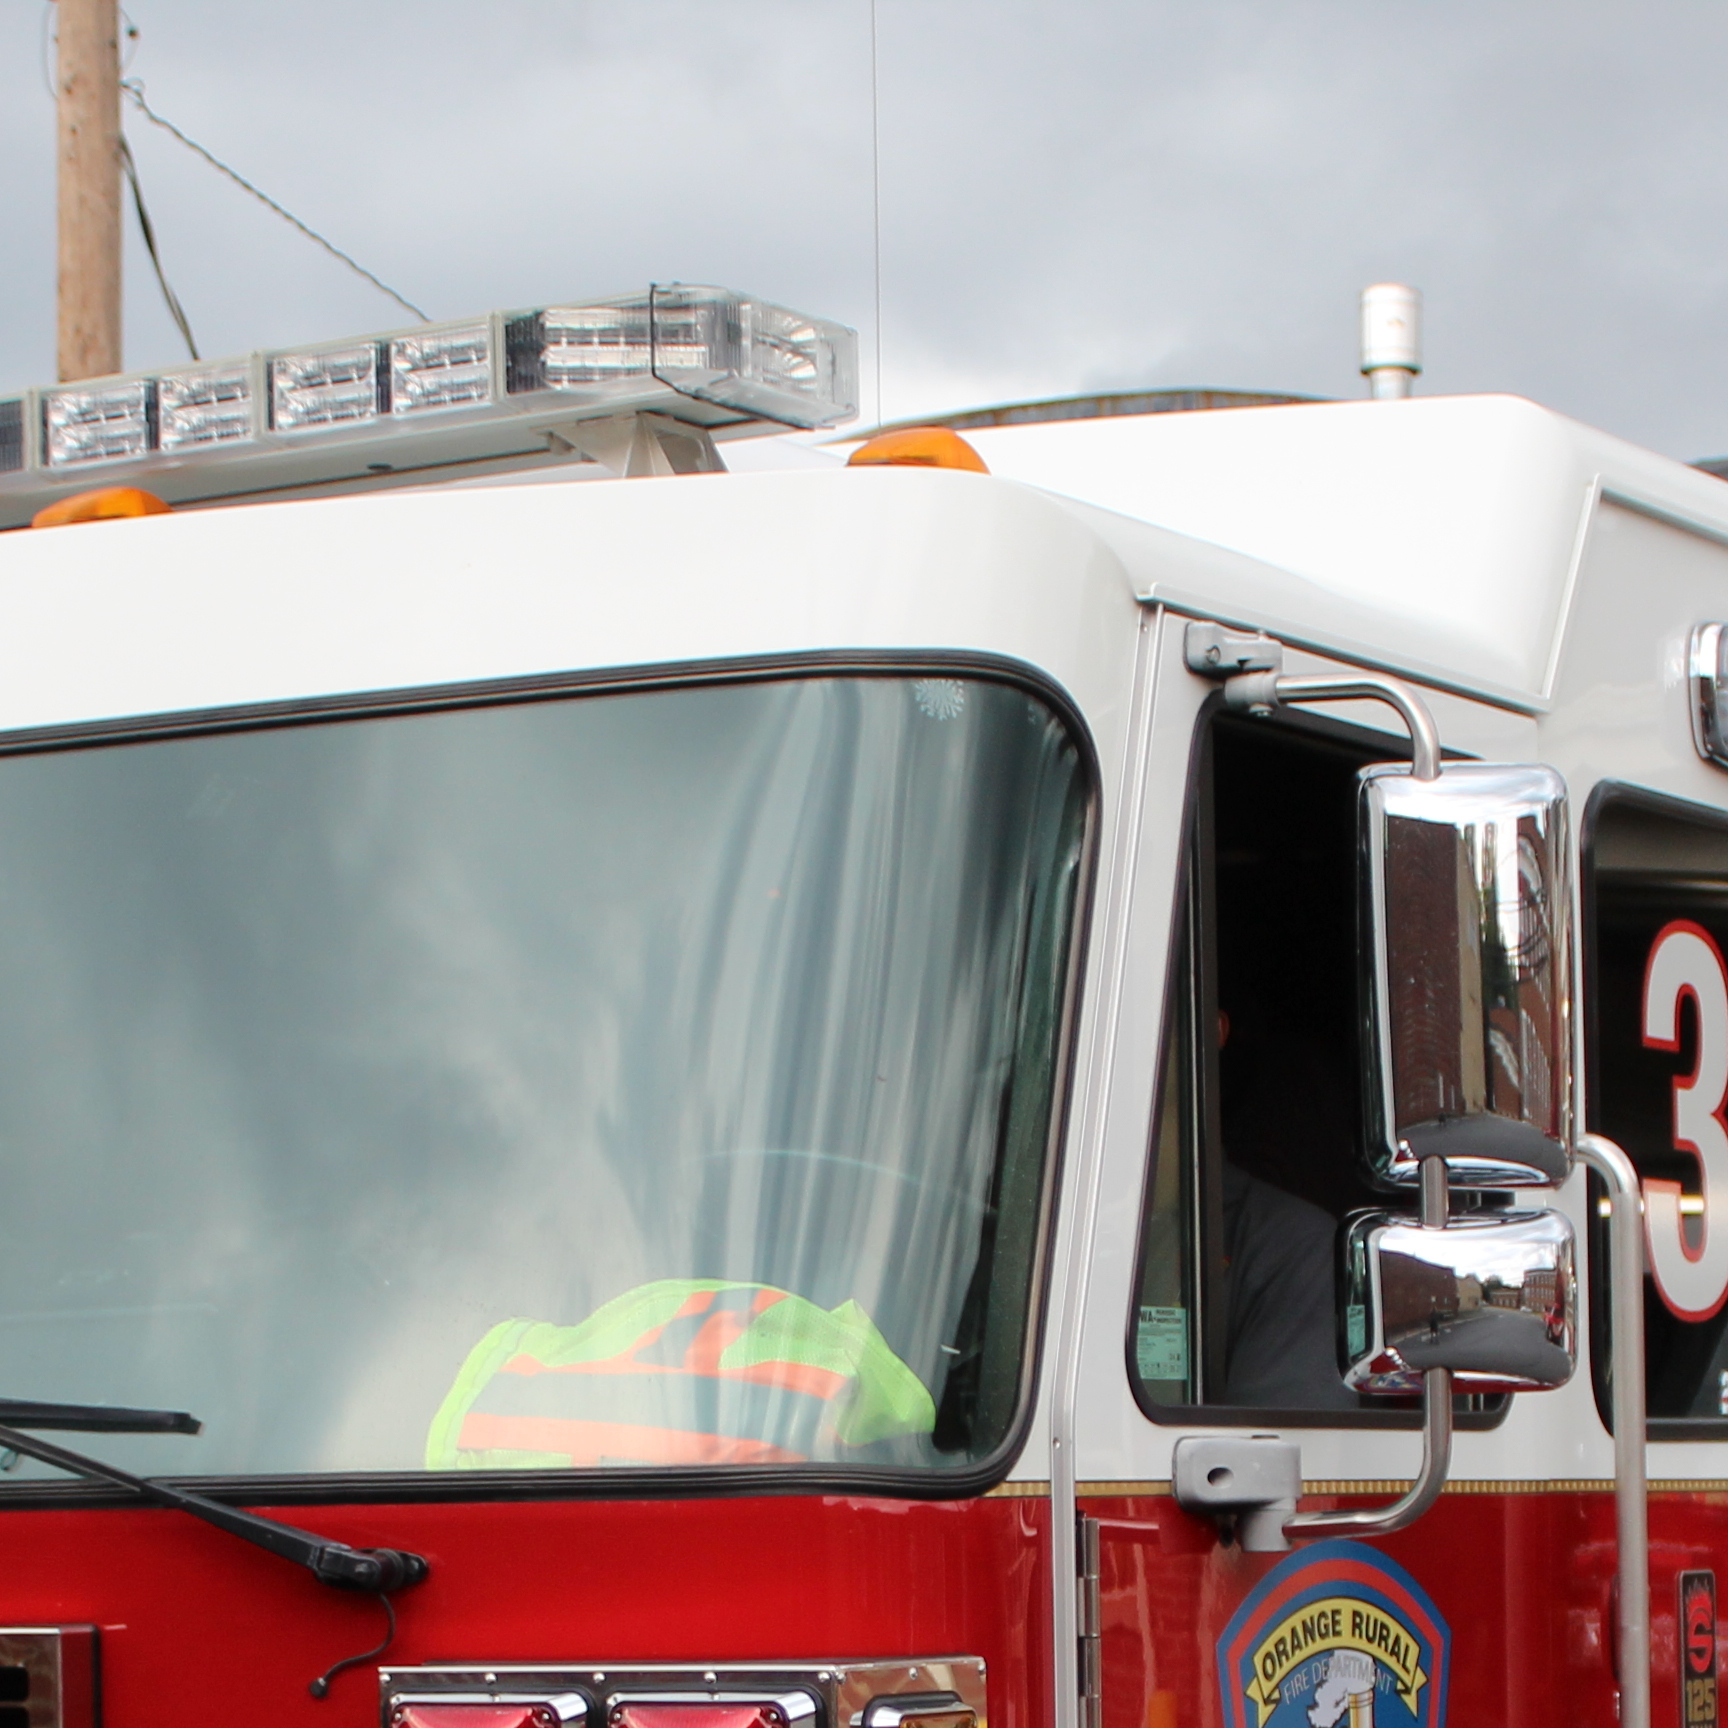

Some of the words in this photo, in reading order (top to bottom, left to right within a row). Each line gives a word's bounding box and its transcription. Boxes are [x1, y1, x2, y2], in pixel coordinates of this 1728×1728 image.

[1262, 1609, 1343, 1681] ORANGE
[1351, 1609, 1412, 1674] RURAL
[1283, 1667, 1310, 1705] FIRE
[1312, 1654, 1393, 1695] DEPARTMENT
[1686, 1678, 1715, 1722] 125
